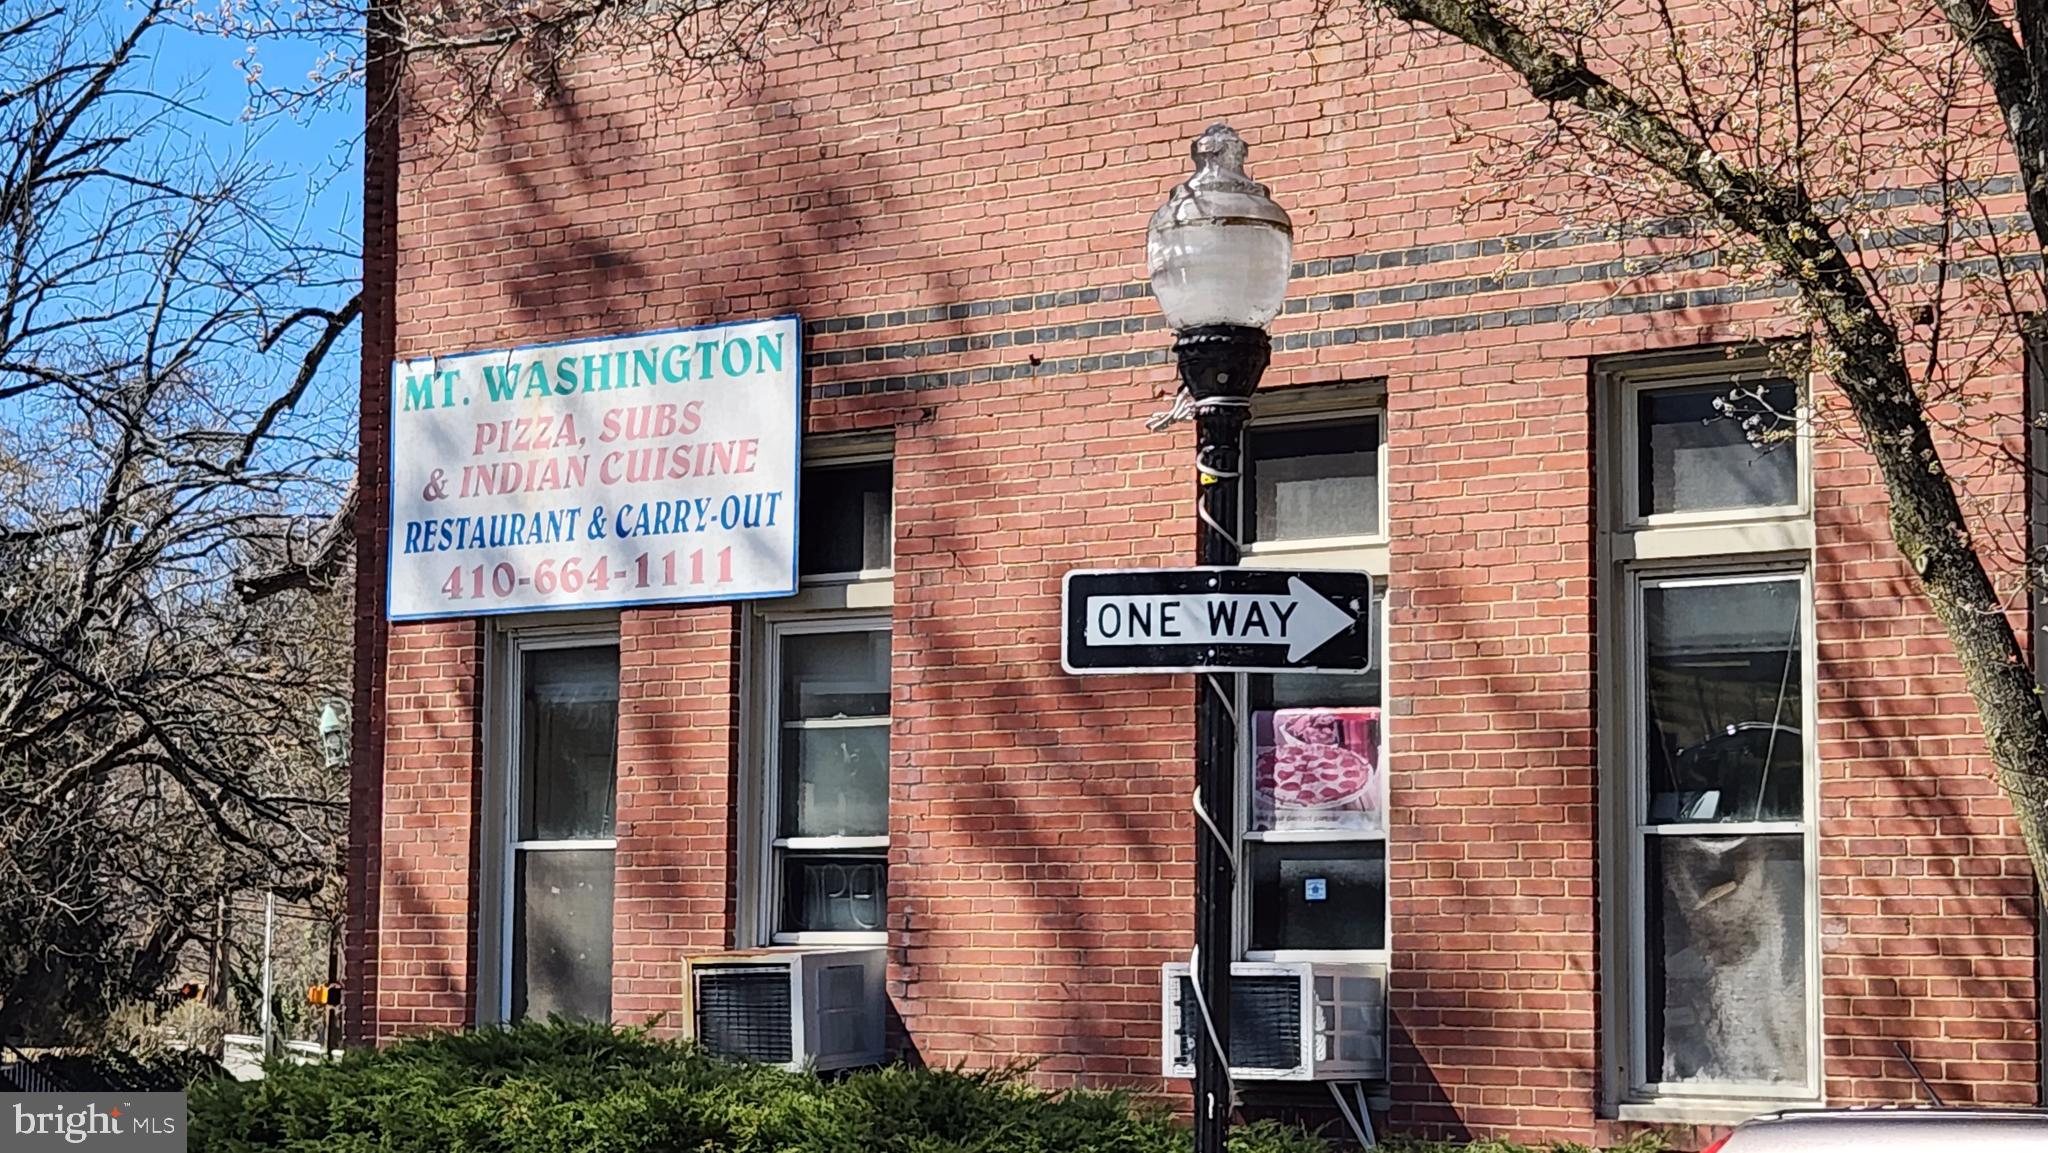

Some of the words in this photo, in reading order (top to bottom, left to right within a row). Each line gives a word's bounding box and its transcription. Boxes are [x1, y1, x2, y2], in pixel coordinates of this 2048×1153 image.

[402, 369, 470, 412] MT.
[482, 332, 785, 402] WASHINGTON
[472, 413, 587, 457] PIZZA,
[598, 400, 705, 444] SUBS
[422, 467, 449, 502] &
[459, 454, 591, 499] INDIAN
[600, 438, 760, 486] CUISINE
[403, 507, 582, 554] RESTAURANT
[586, 505, 609, 540] &
[615, 490, 783, 538] CARRY-OUT
[441, 545, 734, 601] 410-664-1111
[1098, 600, 1181, 638] ONE
[1207, 600, 1299, 637] WAY
